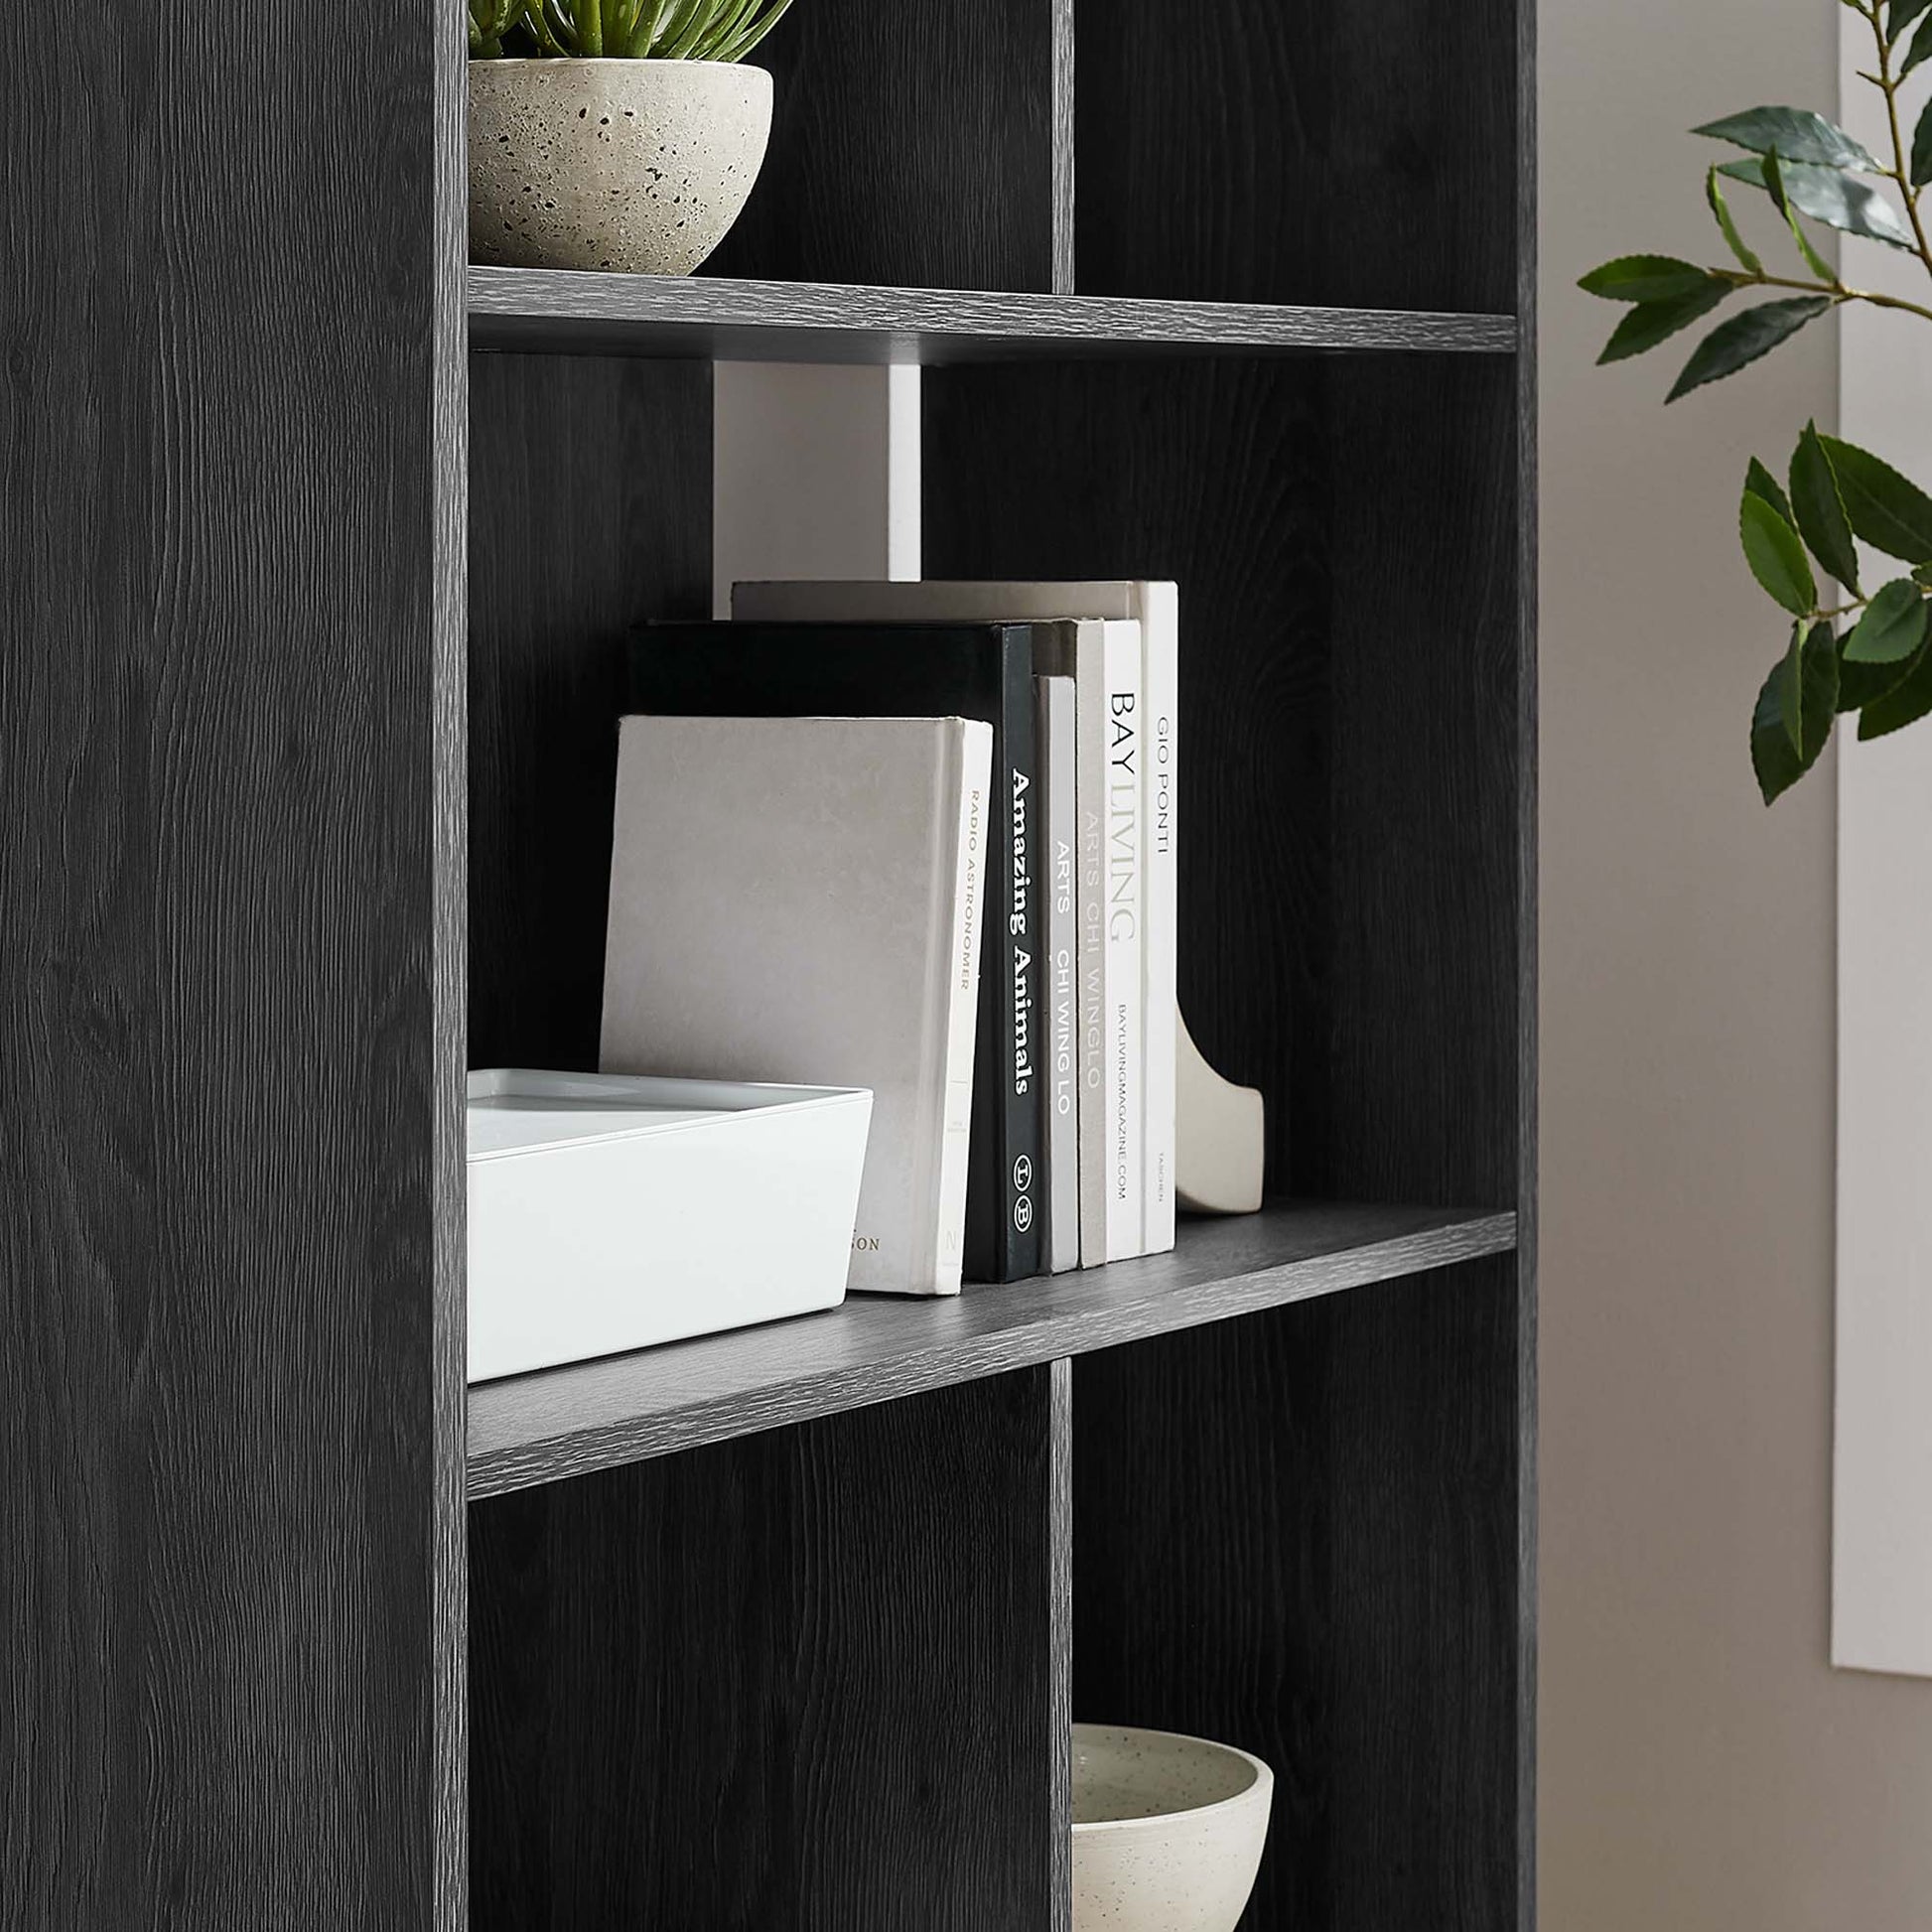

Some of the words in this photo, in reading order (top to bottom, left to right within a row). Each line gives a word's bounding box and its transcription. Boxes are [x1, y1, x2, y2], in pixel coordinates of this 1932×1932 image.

[1158, 717, 1169, 763] GIO
[968, 790, 979, 851] RADIO
[1087, 812, 1099, 886] ARTS
[1158, 773, 1169, 855] PONTI
[1010, 768, 1032, 935] Amazing
[1057, 841, 1069, 913] ARTS
[960, 858, 976, 990] ASTRONOMER
[1087, 902, 1100, 952] CHI
[1057, 949, 1069, 993] CHI
[1015, 946, 1033, 1095] Animals
[1057, 1001, 1069, 1072] WING
[1057, 1080, 1069, 1114] LO
[1118, 1004, 1127, 1199] BAYLIVINGMAGAZINE.COM
